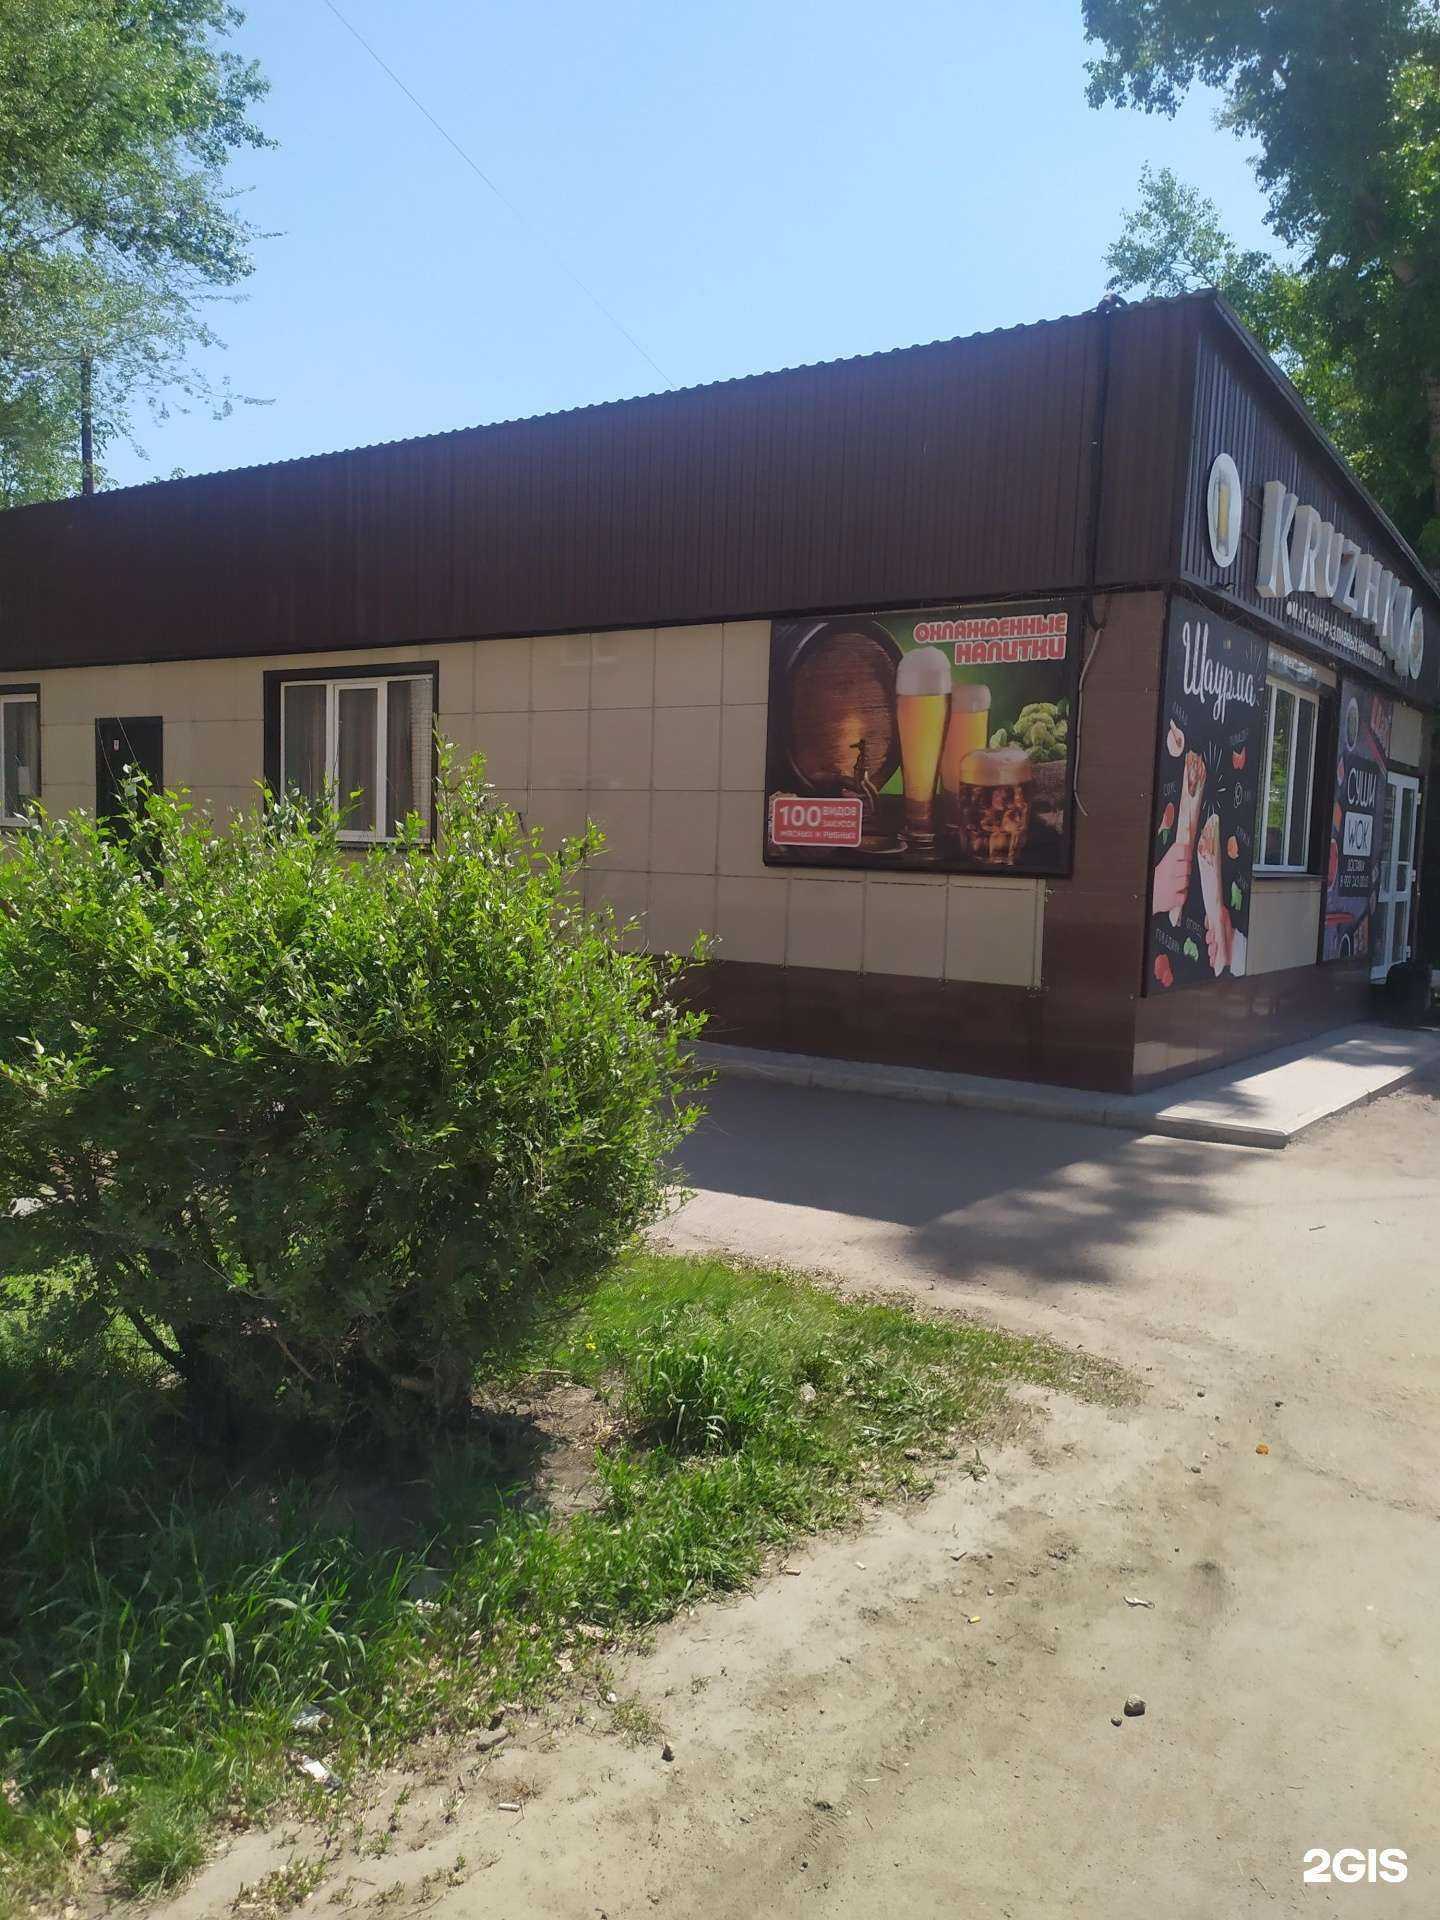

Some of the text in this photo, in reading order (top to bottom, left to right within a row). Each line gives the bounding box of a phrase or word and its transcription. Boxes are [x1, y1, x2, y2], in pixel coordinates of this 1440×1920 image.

[955, 636, 1068, 665] НАПИТКИ
[1182, 621, 1255, 724] Шаурма
[1347, 767, 1377, 808] СУШИ
[780, 805, 822, 828] 100
[1347, 820, 1369, 850] WOK
